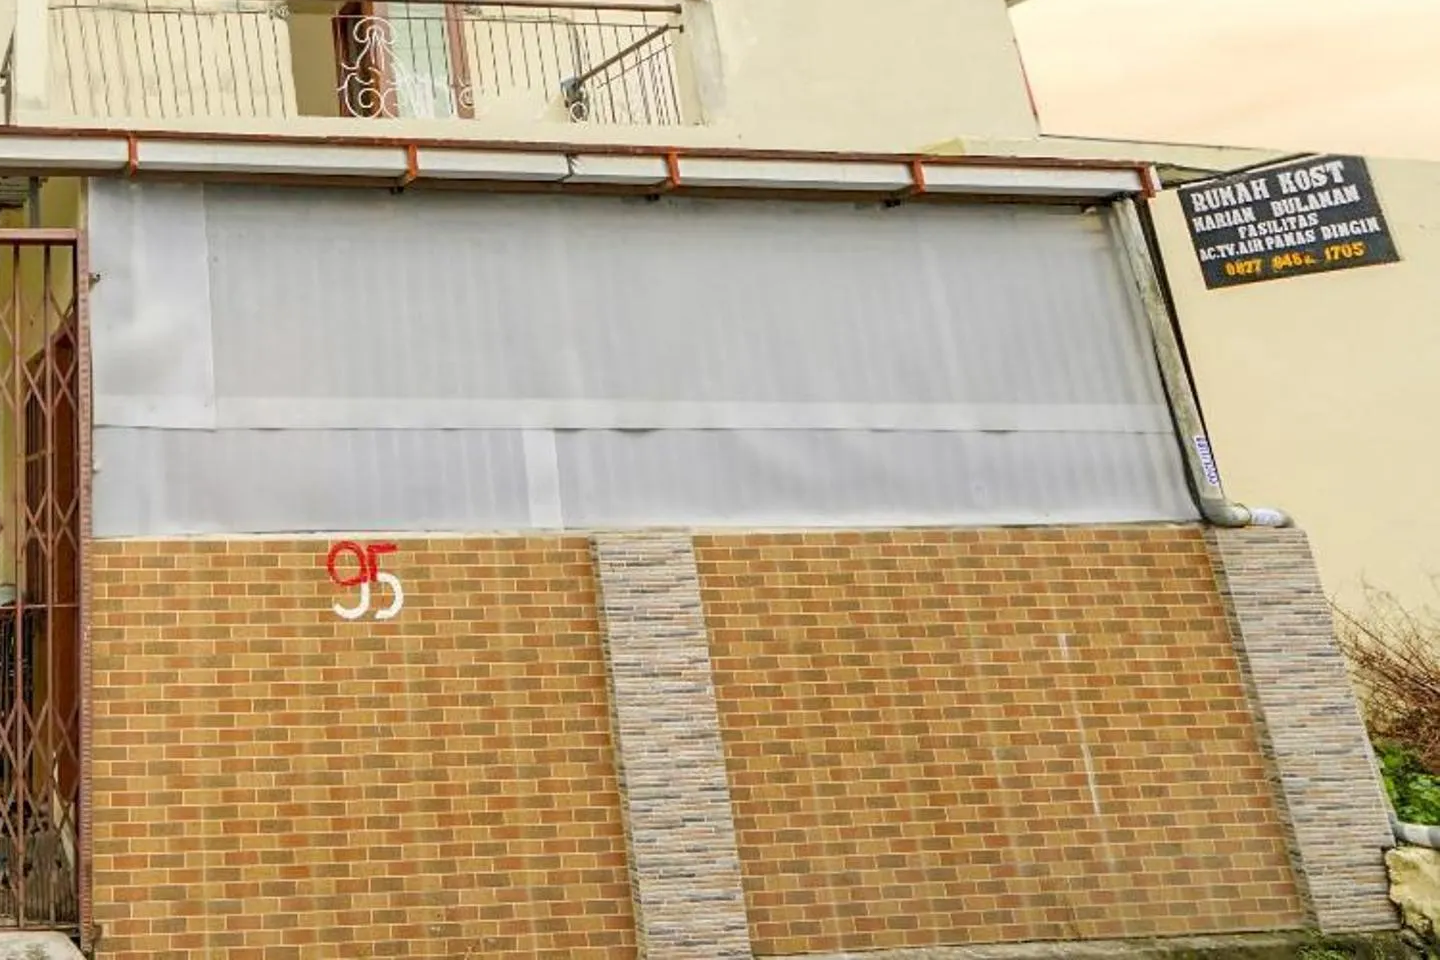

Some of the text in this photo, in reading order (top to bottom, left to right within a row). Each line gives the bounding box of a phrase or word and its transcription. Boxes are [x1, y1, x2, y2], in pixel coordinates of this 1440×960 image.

[1190, 160, 1345, 213] RUMAH KOST
[1270, 184, 1361, 218] BULANAN
[1238, 212, 1320, 239] FASILITAS
[1265, 229, 1316, 252] PANAS
[1320, 215, 1382, 242] DINGIN
[1323, 241, 1366, 263] 1705
[327, 541, 404, 620] 95
